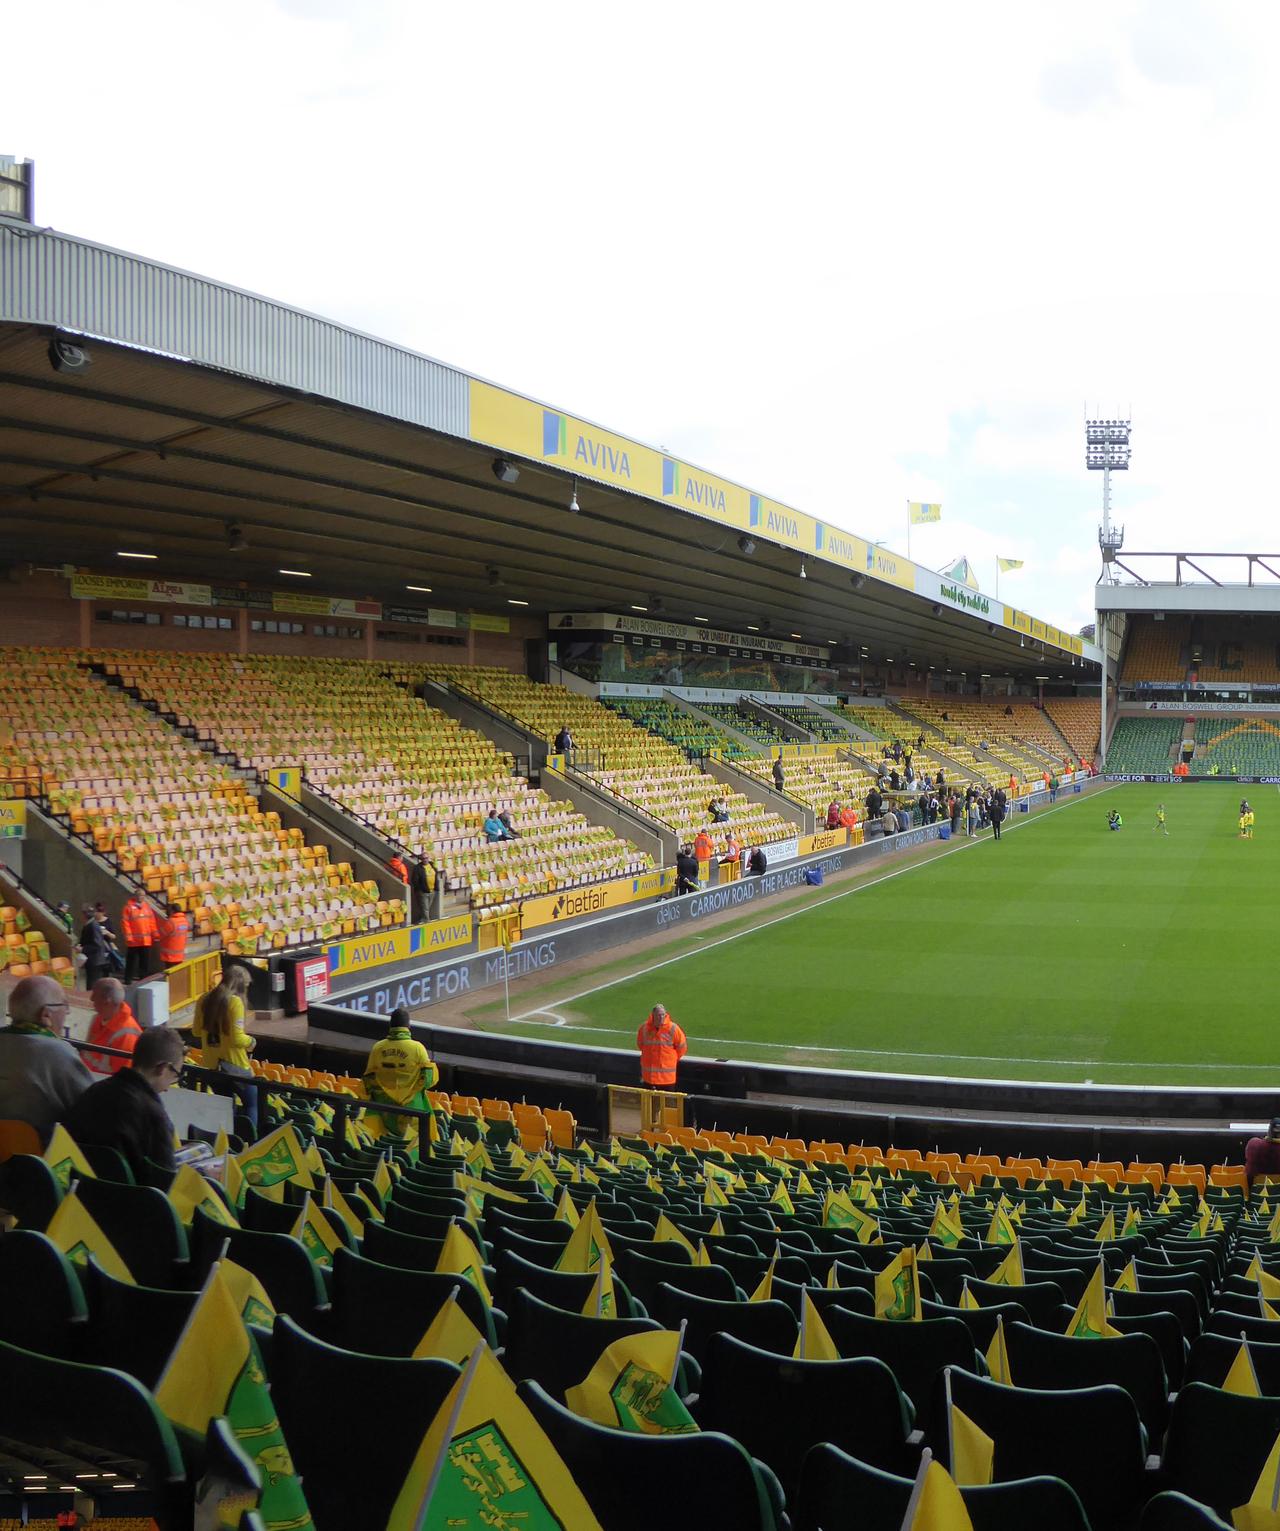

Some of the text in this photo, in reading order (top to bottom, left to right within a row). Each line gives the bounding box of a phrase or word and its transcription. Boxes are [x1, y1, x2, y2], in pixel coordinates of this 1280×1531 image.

[575, 436, 631, 478] AVIVA
[685, 479, 726, 513] AVIVA
[767, 511, 799, 540] AVIVA
[829, 536, 854, 561] AVIVA
[878, 556, 897, 576] AVIVA
[741, 636, 766, 650] INSURANCE
[1161, 702, 1180, 710] ALAN
[1183, 702, 1214, 710] BOSWELL
[1216, 703, 1243, 711] GROUP
[816, 834, 836, 850] betfair
[642, 879, 658, 890] AVIVA
[690, 889, 730, 917] CARROW
[731, 882, 754, 908] ROAD
[761, 876, 775, 895] THE
[777, 871, 798, 889] PLACE
[567, 889, 608, 916] betfair
[430, 924, 469, 946] AVIVA
[351, 940, 396, 965] AVIVA
[375, 976, 431, 1015] PLACE
[436, 967, 470, 998] FOR
[485, 942, 556, 984] MEETINGS
